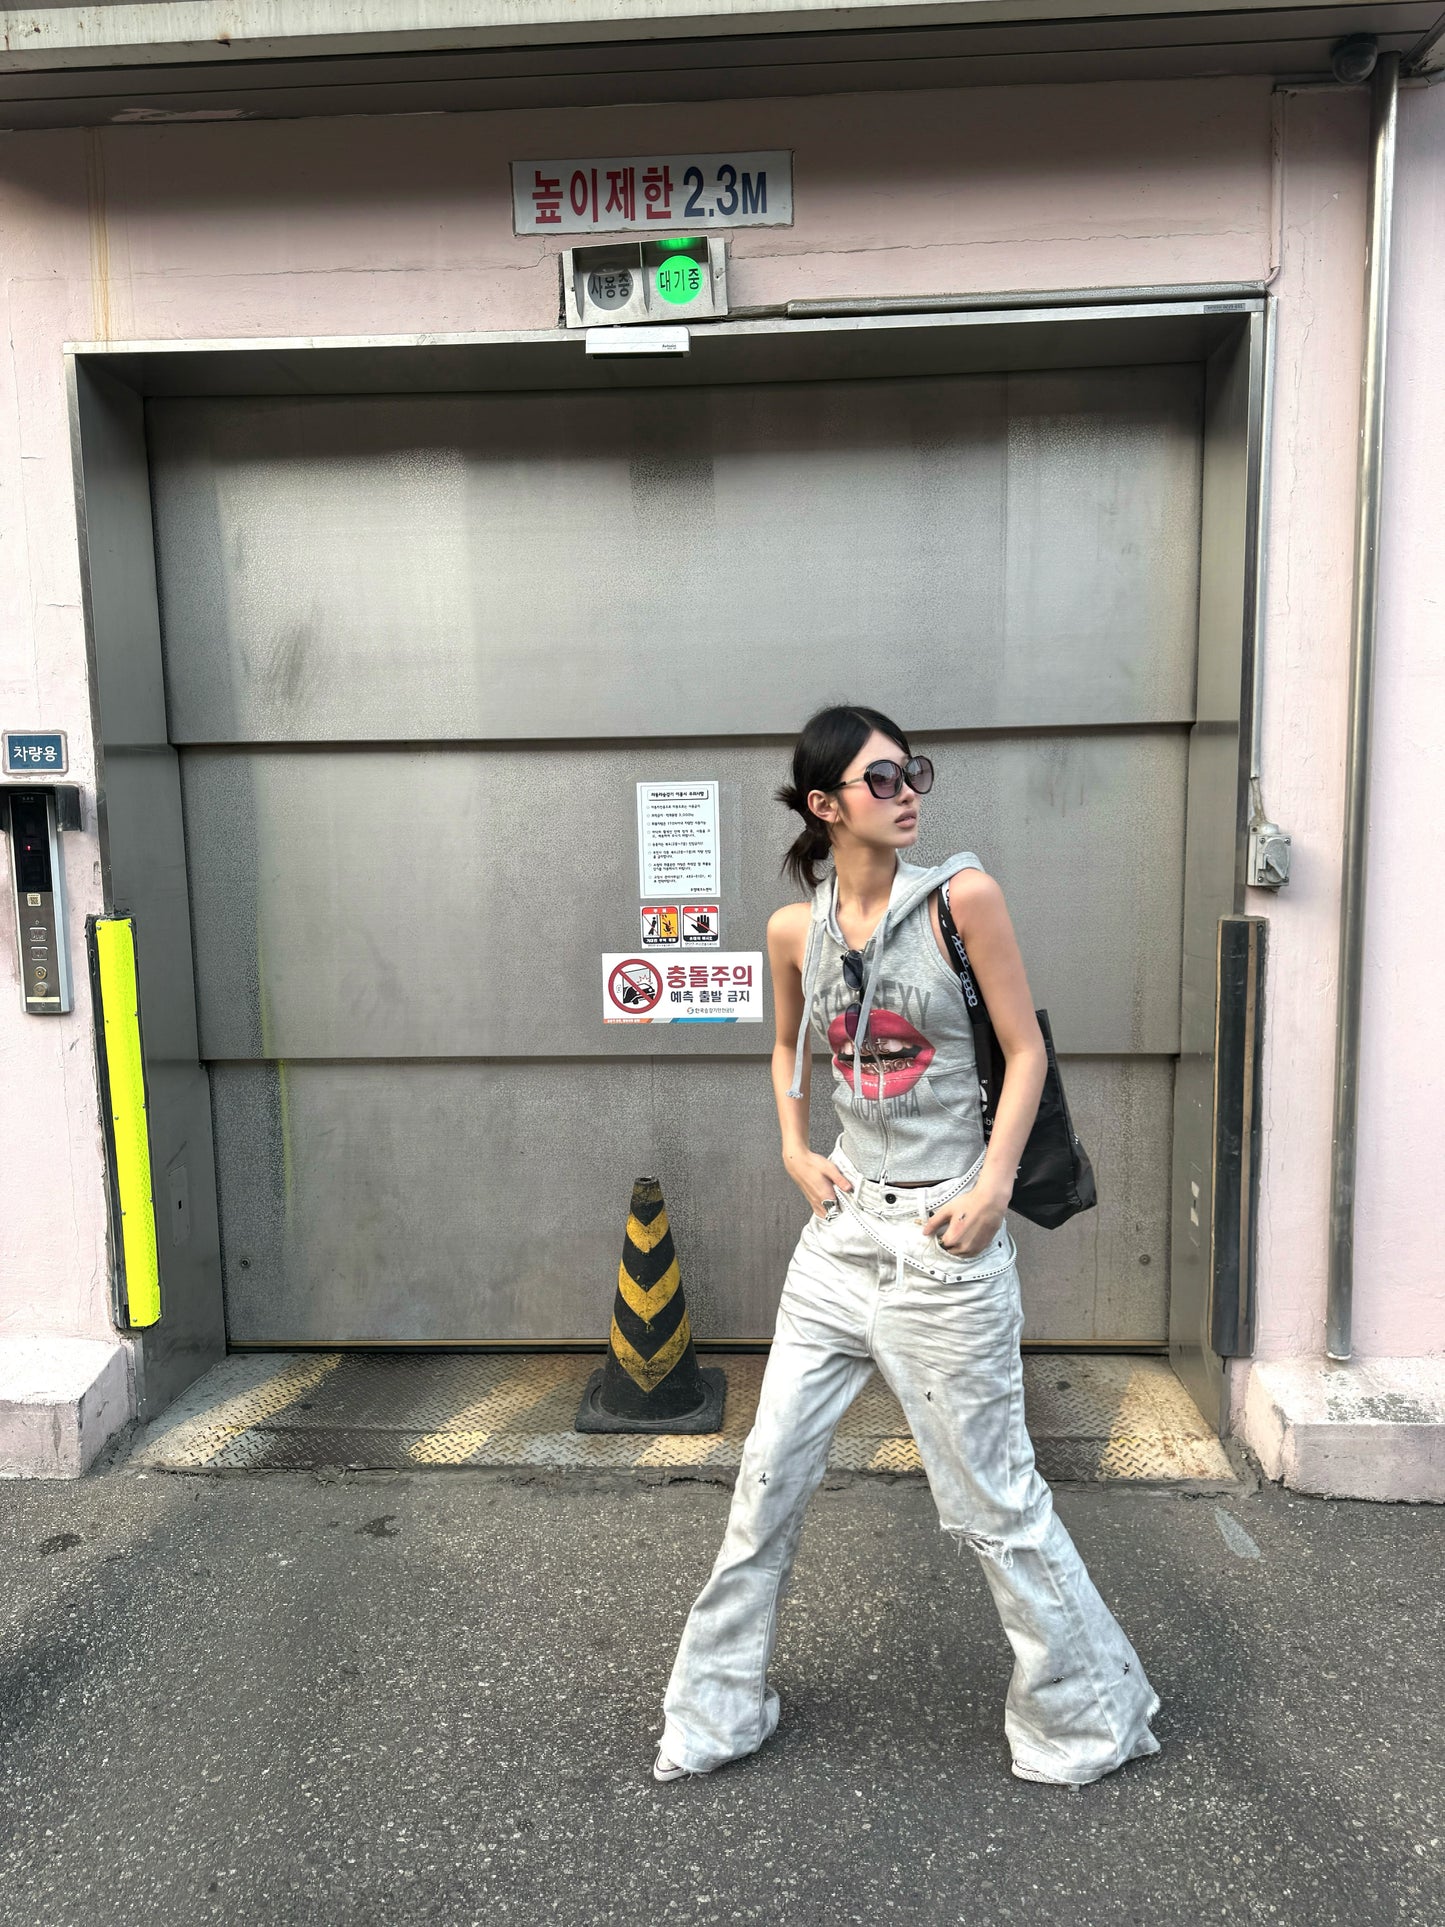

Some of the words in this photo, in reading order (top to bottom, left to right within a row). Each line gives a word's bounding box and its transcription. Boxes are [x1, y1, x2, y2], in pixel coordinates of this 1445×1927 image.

[532, 165, 673, 224] 높이제한
[683, 164, 767, 218] 2.3M
[591, 272, 630, 299] 사용중
[659, 268, 700, 291] 대기중
[13, 745, 58, 762] 차량용
[666, 965, 752, 989] 충돌주의
[670, 990, 694, 1003] 예측
[698, 990, 722, 1003] 출발
[727, 990, 750, 1003] 금지
